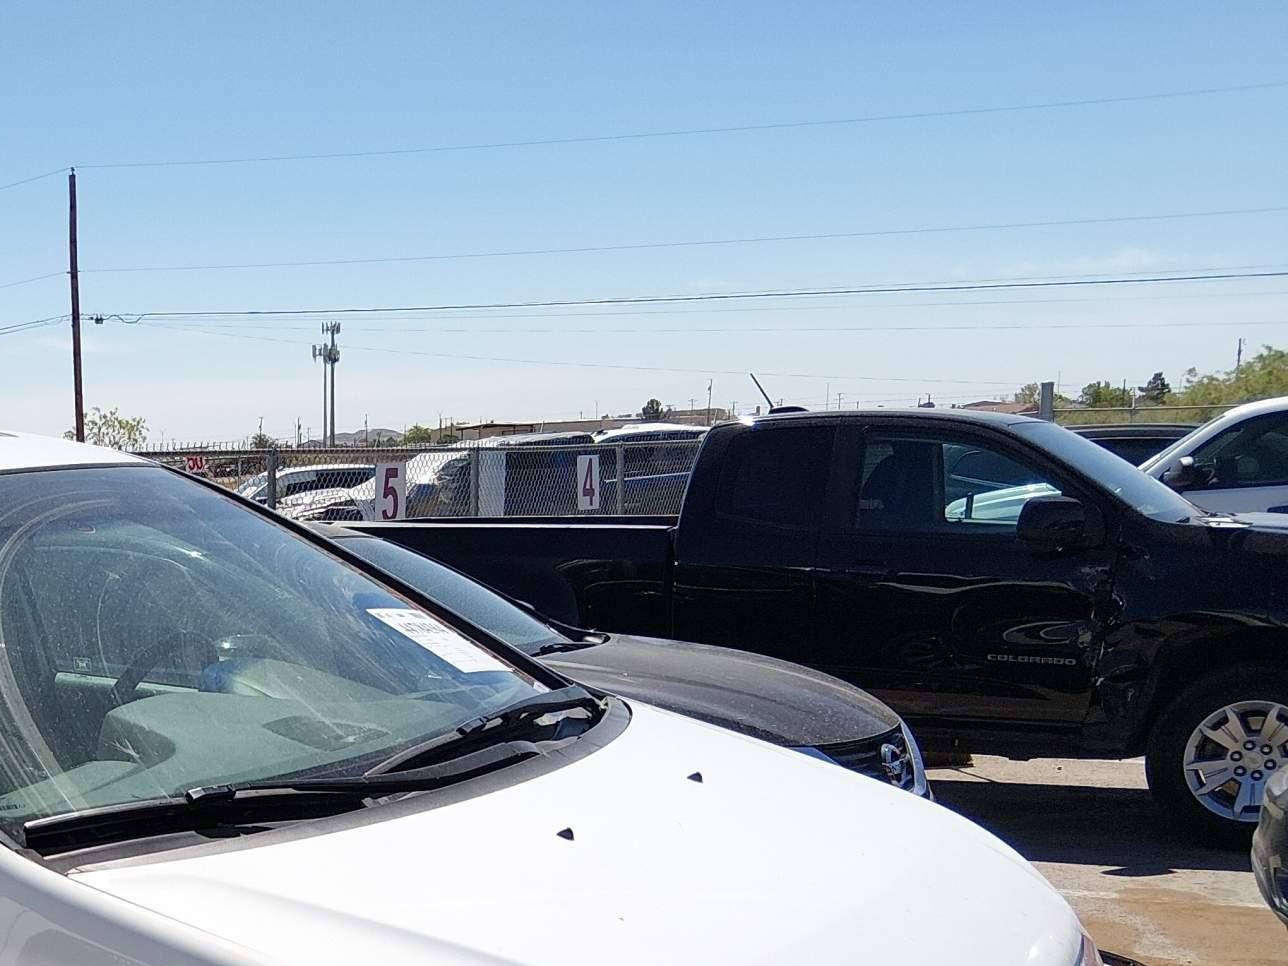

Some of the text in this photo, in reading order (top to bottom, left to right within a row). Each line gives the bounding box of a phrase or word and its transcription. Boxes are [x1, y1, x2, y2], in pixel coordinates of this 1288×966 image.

[382, 467, 399, 520] 5
[583, 457, 595, 506] 4
[987, 653, 1076, 666] COLORADO
